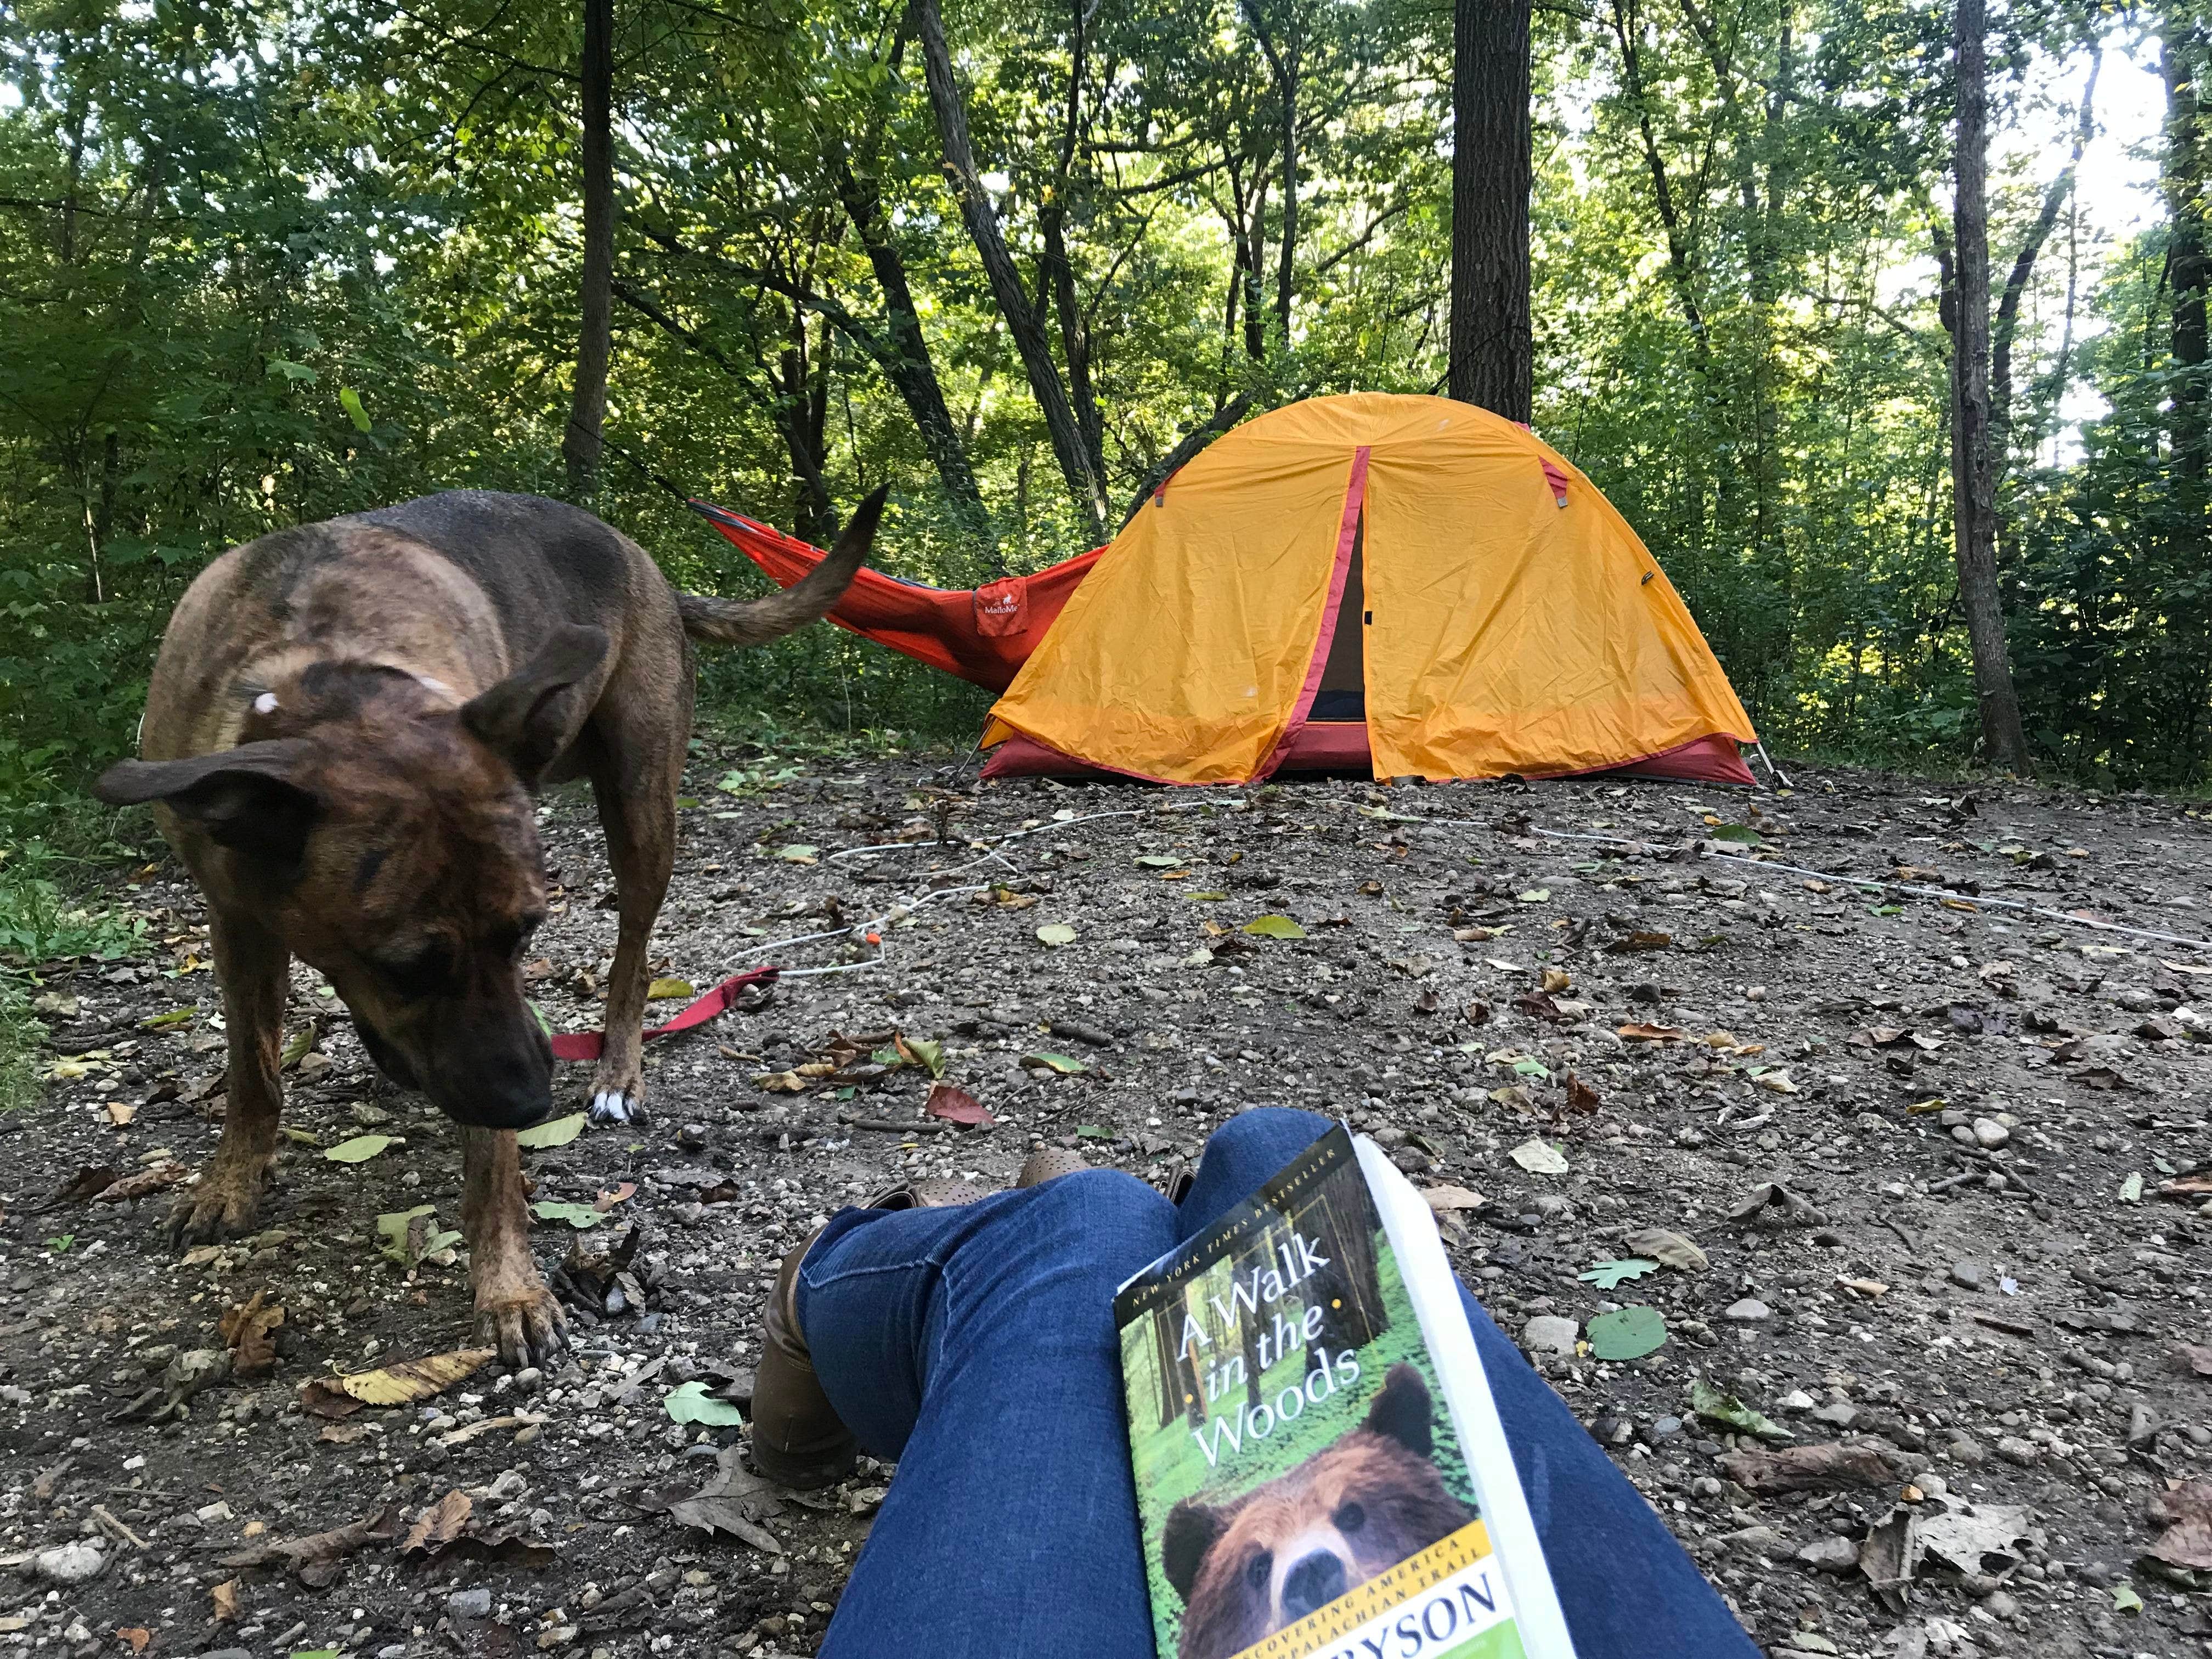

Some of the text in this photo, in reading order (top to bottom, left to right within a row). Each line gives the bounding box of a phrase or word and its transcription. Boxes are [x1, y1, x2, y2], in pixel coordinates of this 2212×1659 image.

[985, 605, 1018, 614] MalloMe
[1133, 1149, 1335, 1307] NEW YORK TIMES BESTSELLER
[1176, 1232, 1331, 1363] A Walk
[1207, 1305, 1324, 1402] in the
[1190, 1347, 1361, 1468] Woods
[1367, 1538, 1459, 1598] AMERICA
[1418, 1548, 1481, 1588] TRAIL
[1331, 1572, 1496, 1659] YSON
